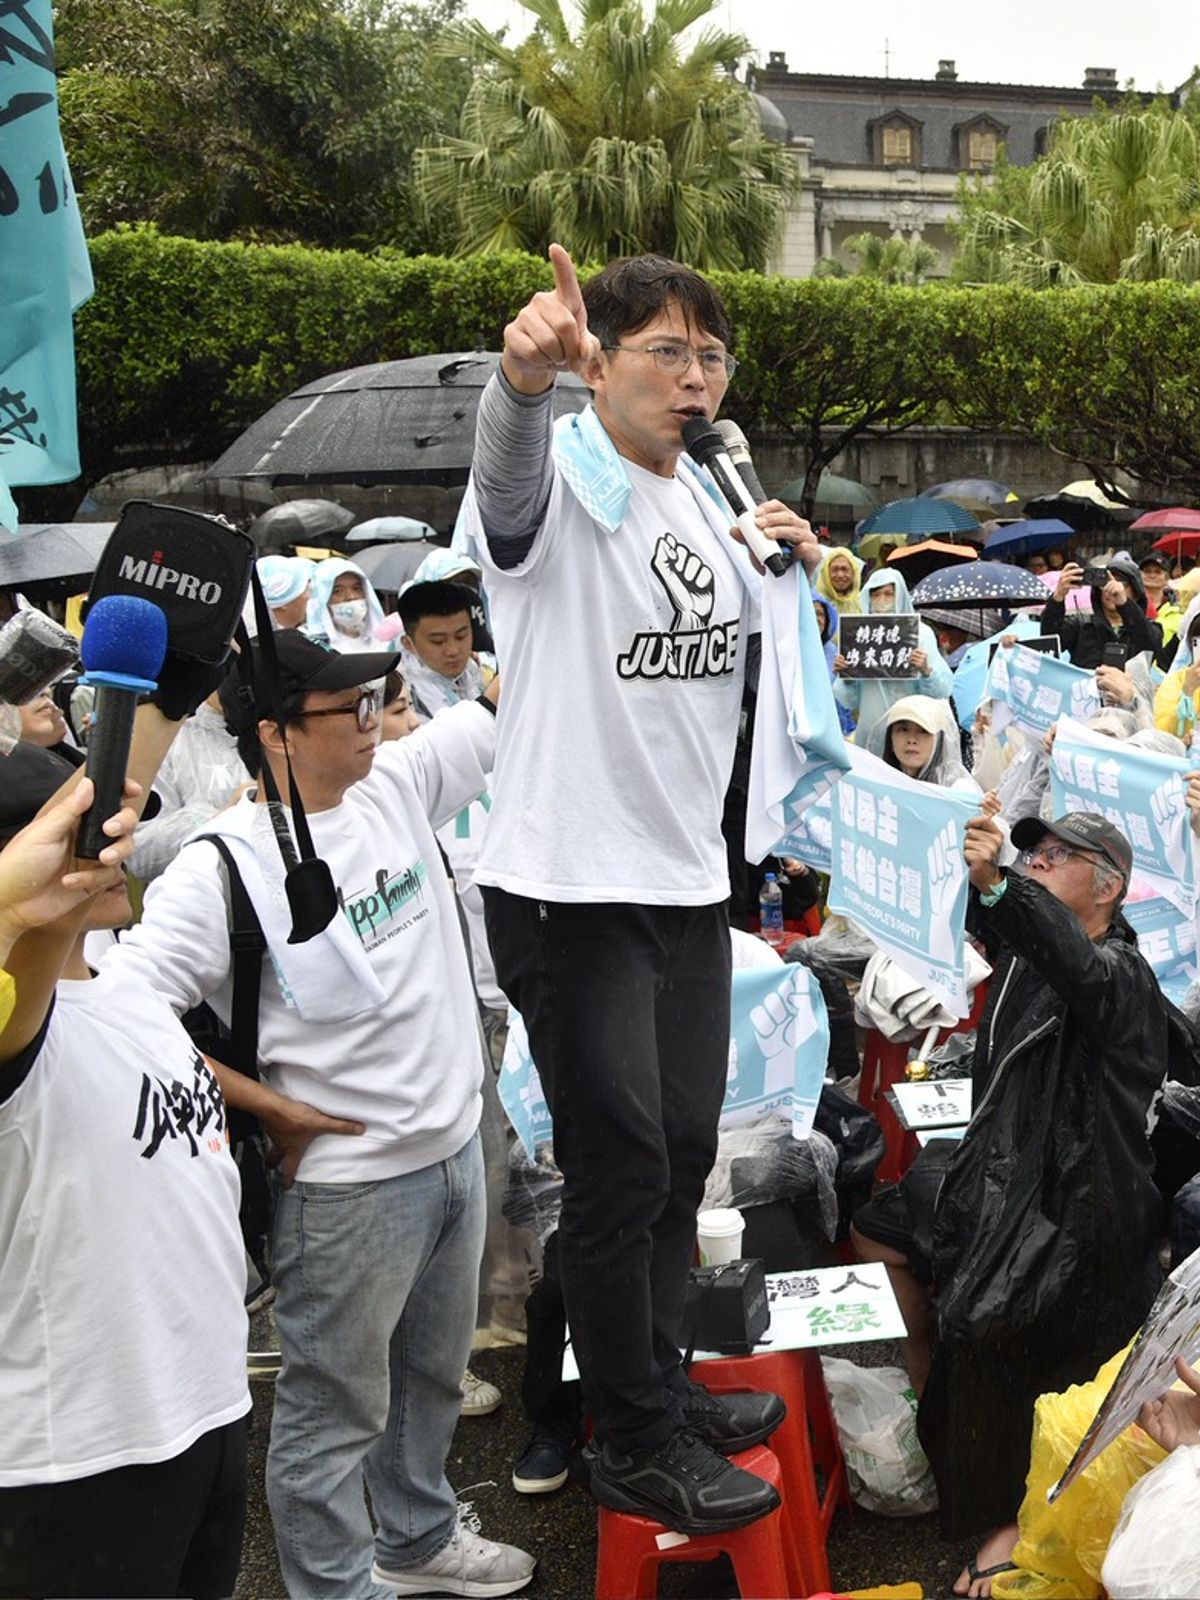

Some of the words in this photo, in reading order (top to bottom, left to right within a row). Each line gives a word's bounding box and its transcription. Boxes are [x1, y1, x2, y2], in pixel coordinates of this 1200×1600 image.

[617, 619, 741, 680] JUSTICE
[1051, 749, 1122, 799] 把民主
[837, 780, 899, 847] 把民主
[839, 837, 923, 919] 還給台灣
